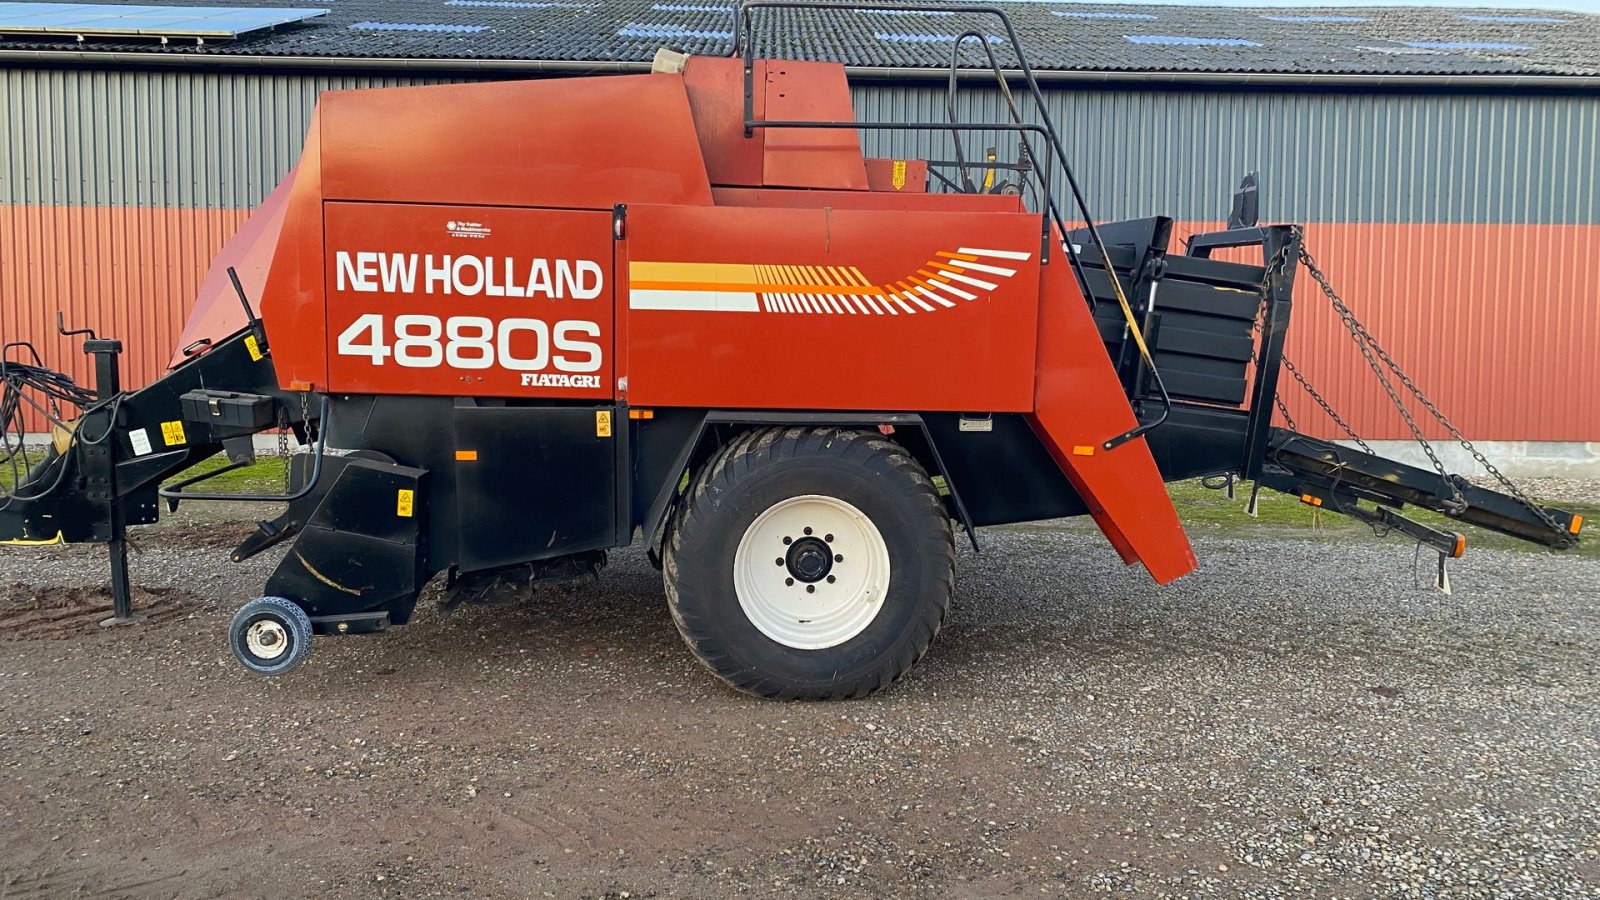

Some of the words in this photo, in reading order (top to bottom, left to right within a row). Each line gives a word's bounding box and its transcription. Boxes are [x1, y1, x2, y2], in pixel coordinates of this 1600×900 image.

[336, 251, 419, 293] NEW
[425, 254, 603, 300] HOLLAND
[337, 313, 602, 372] 4880S
[520, 373, 601, 388] FIATAGRI
